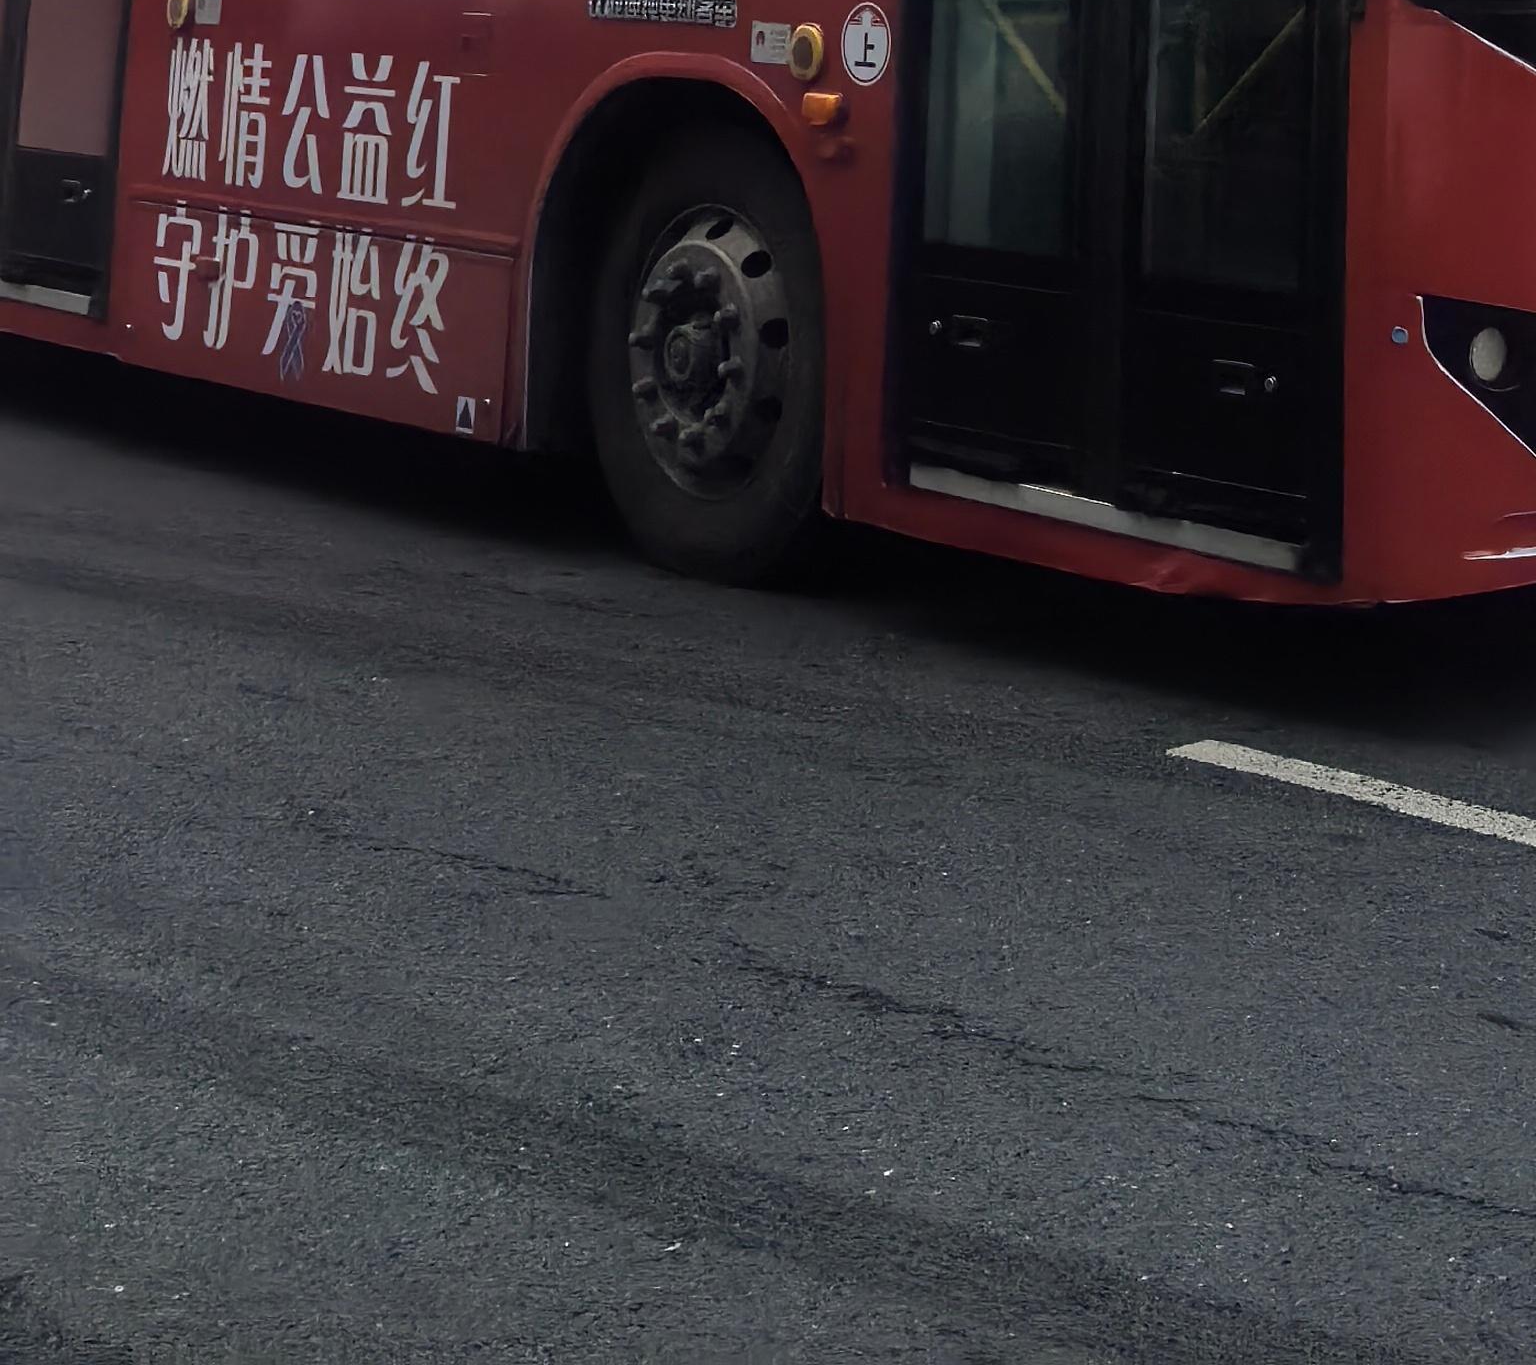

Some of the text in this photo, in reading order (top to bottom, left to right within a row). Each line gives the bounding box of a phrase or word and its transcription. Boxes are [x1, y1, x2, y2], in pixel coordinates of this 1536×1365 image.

[162, 36, 461, 210] 燃情公益红
[853, 32, 877, 68] 上
[153, 199, 450, 395] 守护爱始终
